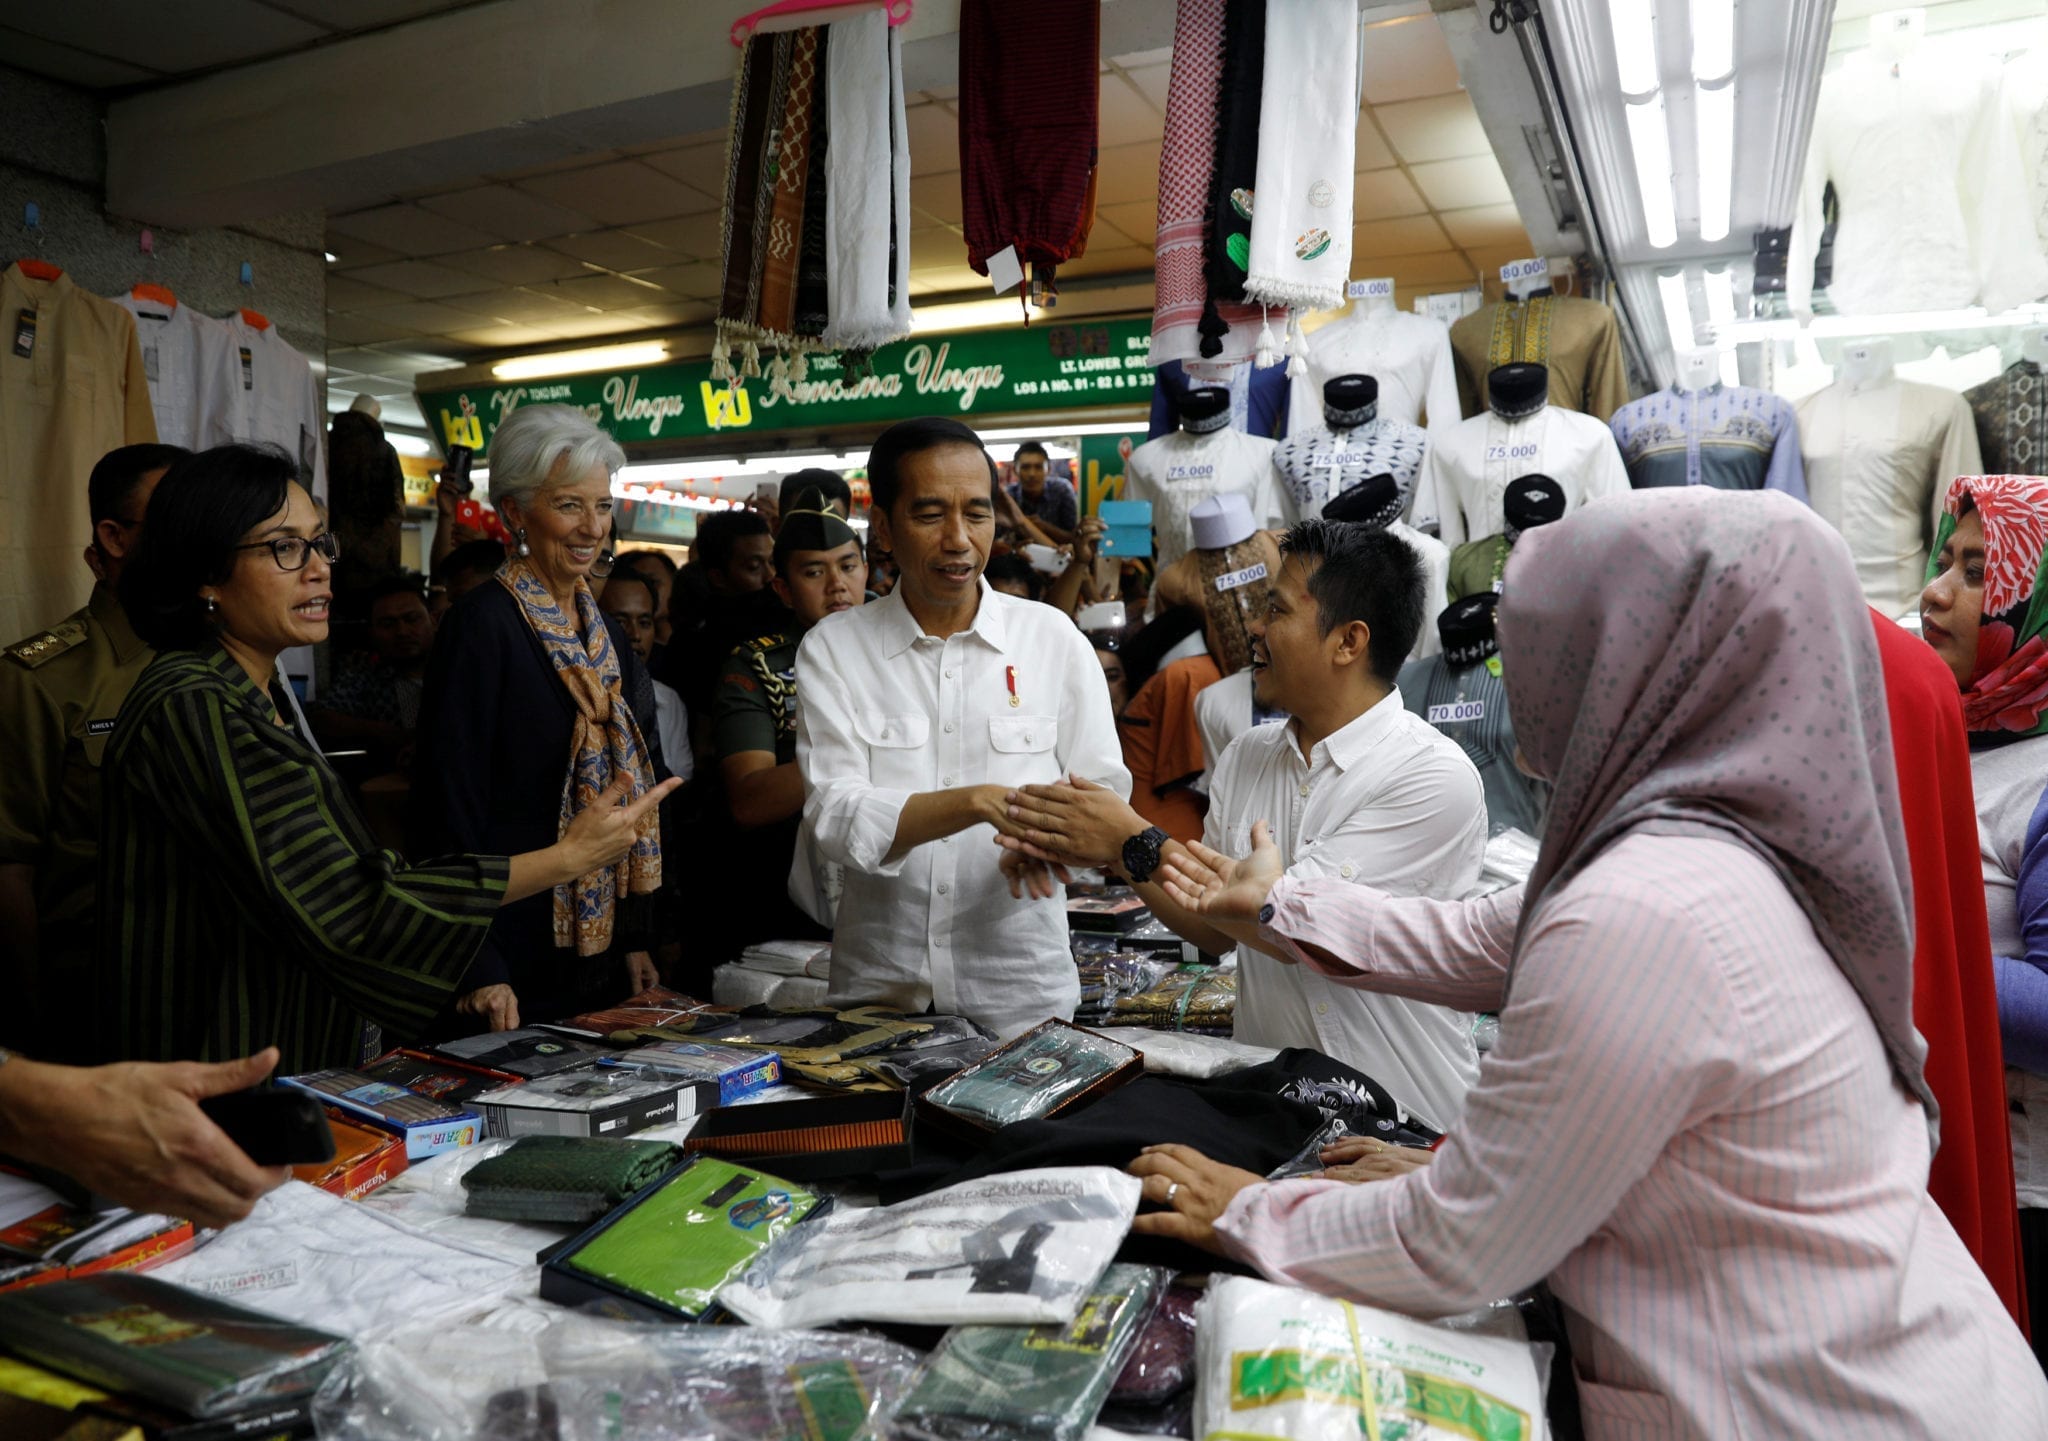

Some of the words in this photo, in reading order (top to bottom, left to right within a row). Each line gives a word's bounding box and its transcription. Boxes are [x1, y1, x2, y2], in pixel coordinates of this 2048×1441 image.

[1501, 258, 1546, 280] 80.000
[1349, 281, 1391, 297] 80.000
[1078, 357, 1121, 373] LOWER
[904, 342, 1004, 411] Ungu
[1013, 381, 1038, 395] LOS
[1040, 380, 1050, 393] A
[1050, 378, 1073, 392] NO.
[1114, 375, 1125, 388] &
[1139, 373, 1156, 386] 33
[603, 375, 685, 437] Ungu
[1314, 452, 1362, 467] 75.000
[1488, 444, 1538, 460] 75.000
[1169, 463, 1214, 479] 75.000
[1216, 564, 1267, 590] 75.000
[1430, 703, 1484, 721] 70.000
[741, 1061, 779, 1087] UZAIR
[432, 1126, 475, 1148] UZAIR
